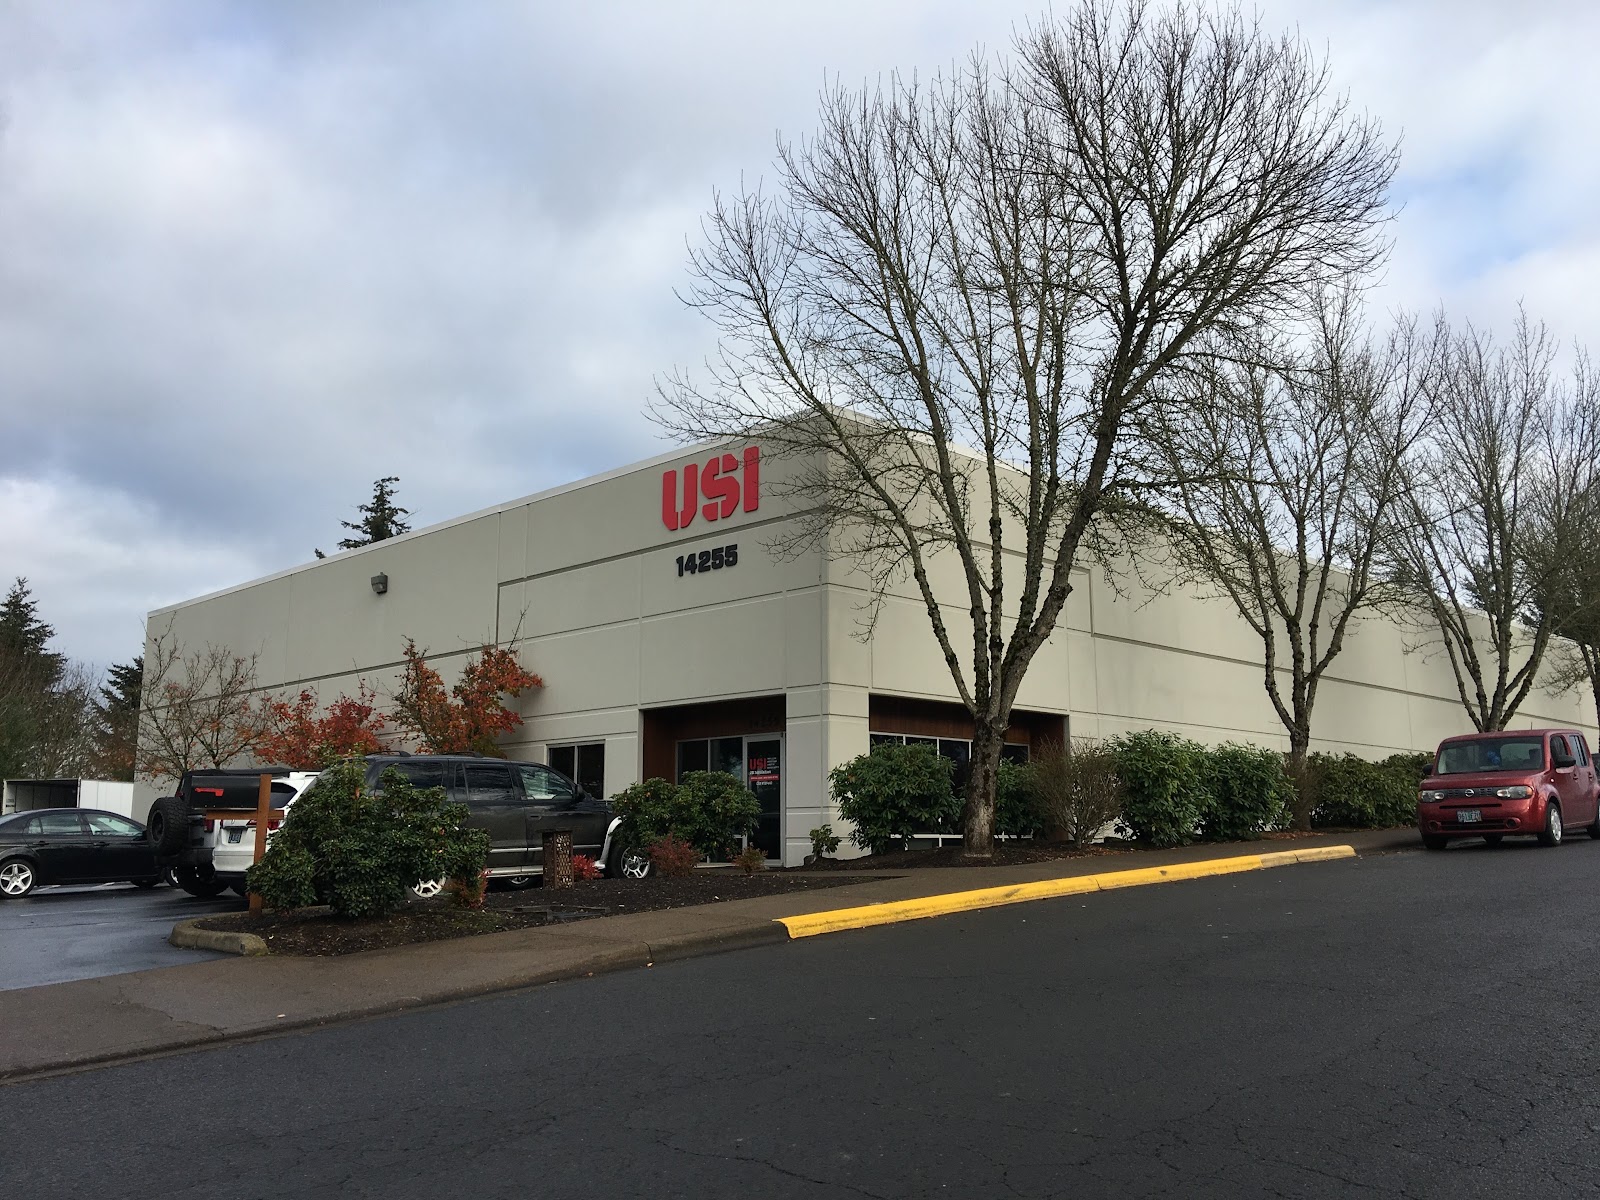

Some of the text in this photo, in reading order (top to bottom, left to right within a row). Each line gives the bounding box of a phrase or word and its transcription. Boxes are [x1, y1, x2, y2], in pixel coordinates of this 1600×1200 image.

[662, 446, 759, 531] USI
[676, 544, 738, 577] 14255
[749, 758, 767, 770] USI
